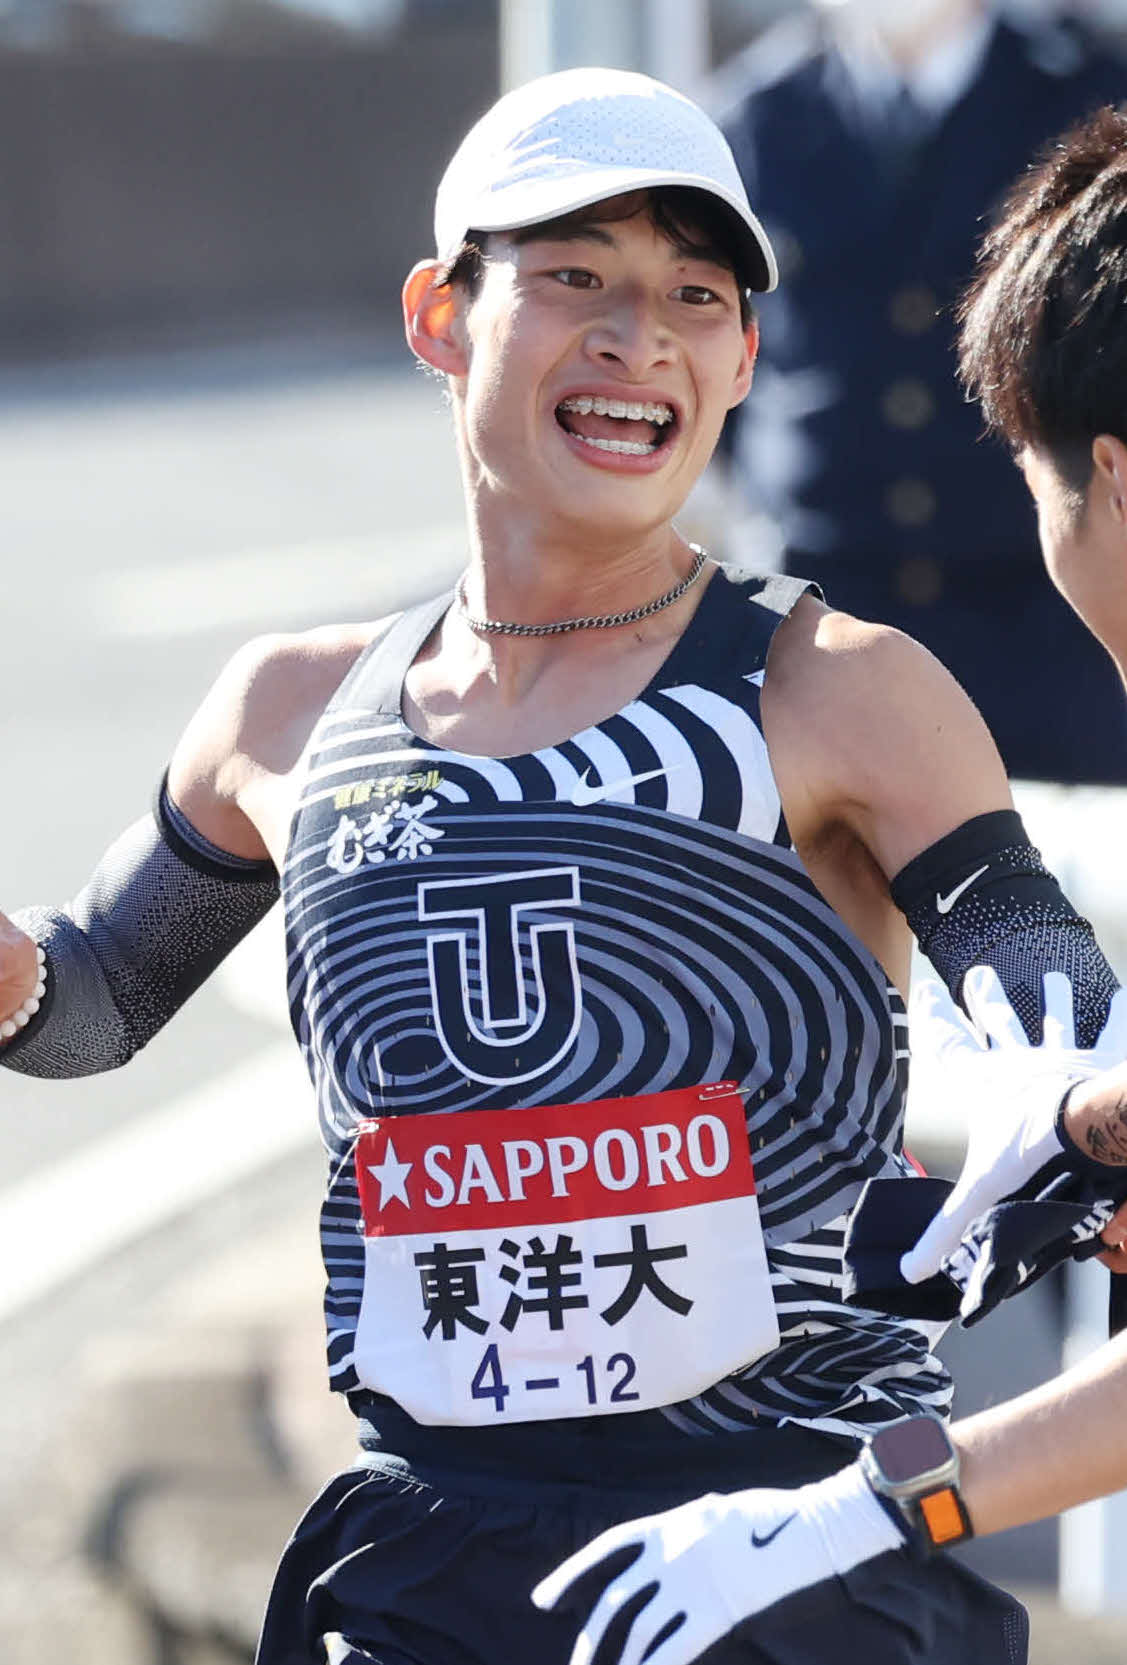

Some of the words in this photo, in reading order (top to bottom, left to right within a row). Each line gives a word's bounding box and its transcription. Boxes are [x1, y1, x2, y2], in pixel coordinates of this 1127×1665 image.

[326, 795, 446, 874] むぎ茶
[423, 1114, 731, 1208] SAPPORO
[413, 1224, 694, 1341] 東洋大
[470, 1343, 640, 1413] 4-12
